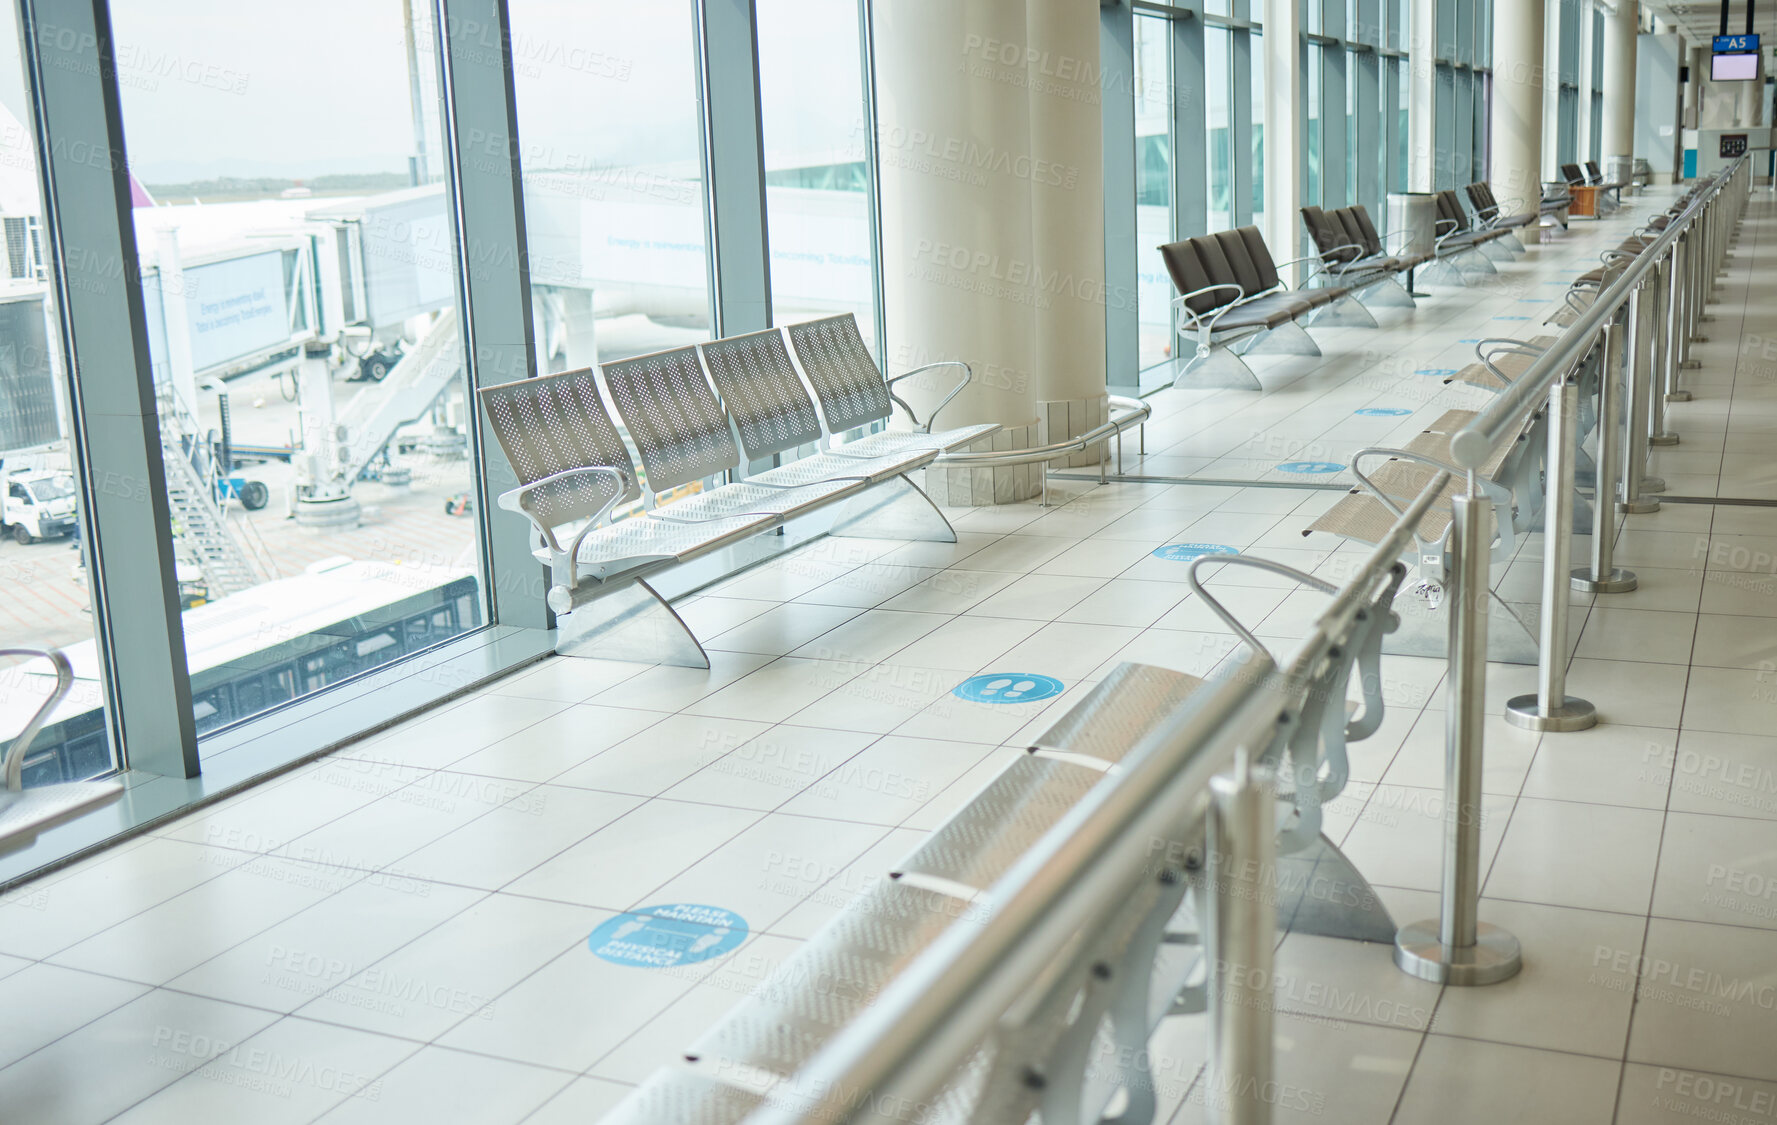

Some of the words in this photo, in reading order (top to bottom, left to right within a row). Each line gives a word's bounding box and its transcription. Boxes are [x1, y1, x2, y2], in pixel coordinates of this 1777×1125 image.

[1729, 37, 1746, 48] A5
[653, 908, 734, 927] MAINTAIN
[674, 904, 730, 918] PLEASE
[607, 940, 682, 959] PHYSICAL
